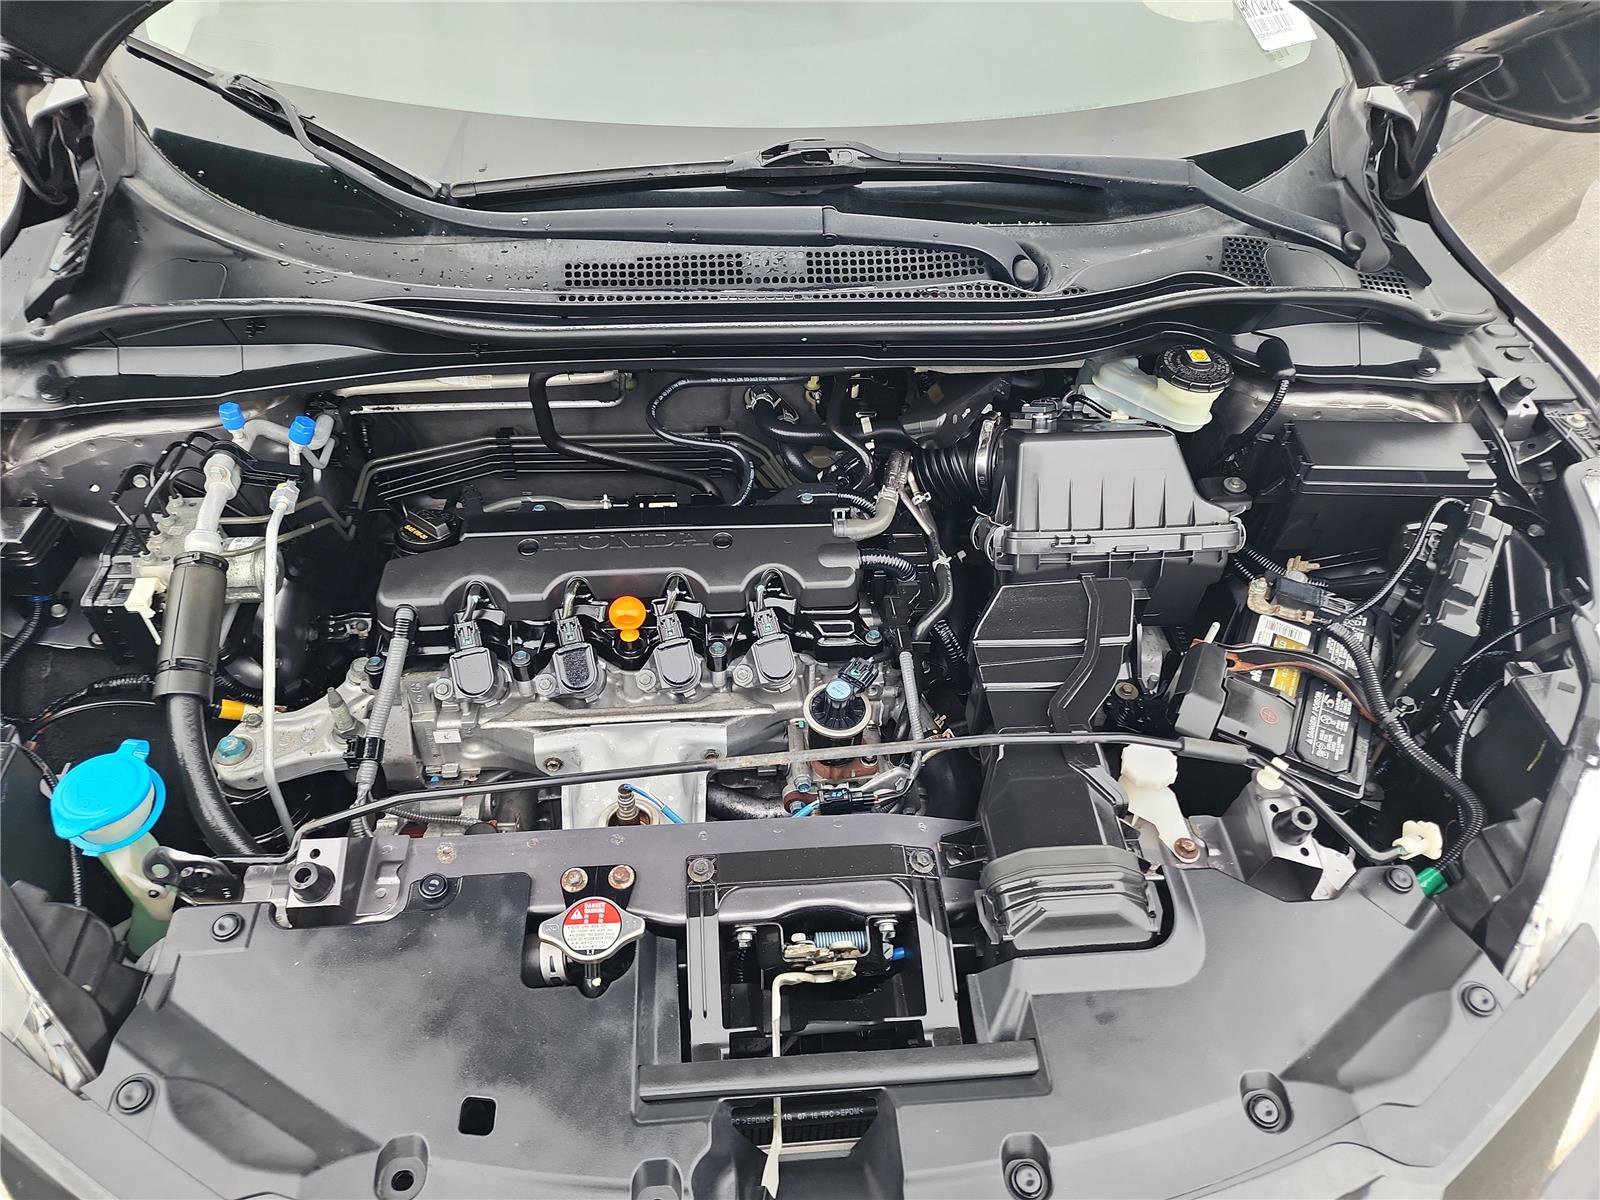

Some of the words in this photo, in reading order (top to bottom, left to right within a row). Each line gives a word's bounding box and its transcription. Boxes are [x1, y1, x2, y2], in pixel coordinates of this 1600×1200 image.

[541, 532, 710, 551] HONDA
[1306, 714, 1317, 739] DANGER
[1312, 691, 1323, 712] POISON
